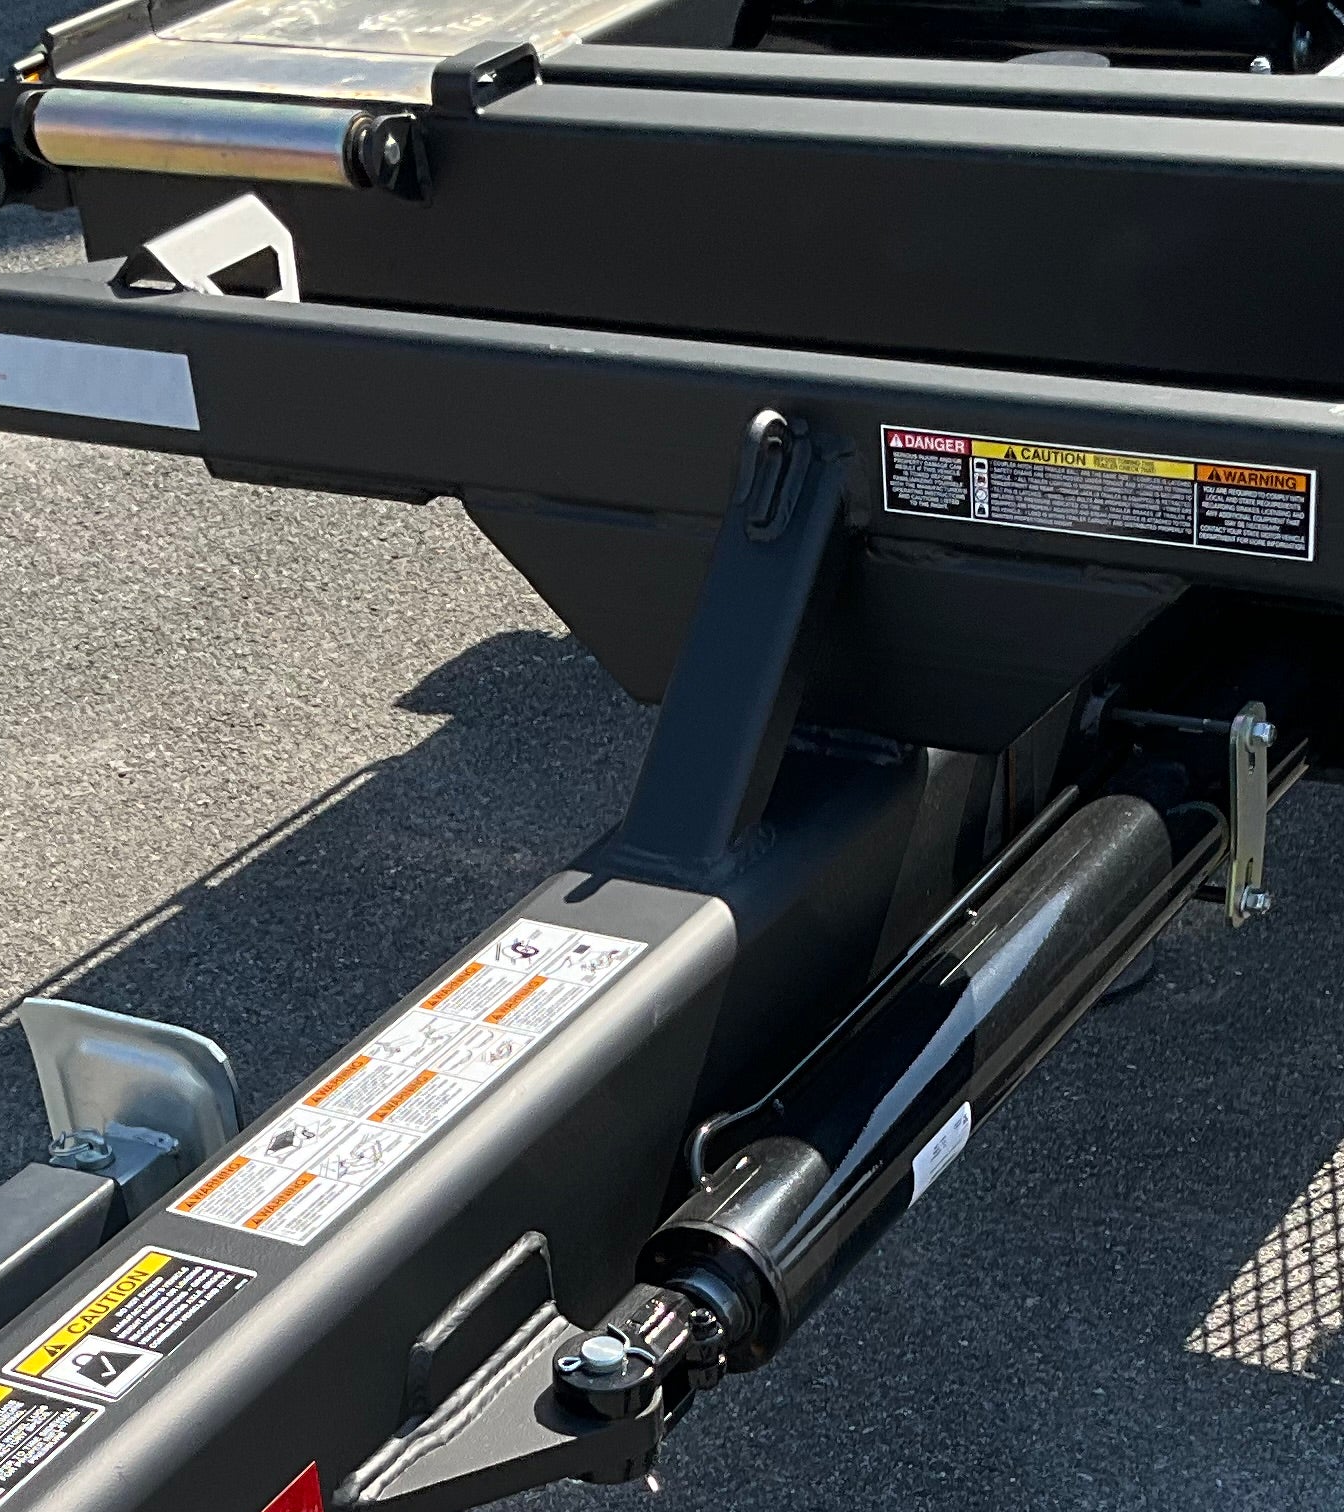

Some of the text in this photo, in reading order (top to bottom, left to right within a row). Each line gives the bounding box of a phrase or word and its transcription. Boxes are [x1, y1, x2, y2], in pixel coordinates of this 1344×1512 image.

[903, 433, 965, 453] DANGER
[1020, 447, 1086, 466] CAUTION
[1223, 469, 1297, 490] WARNING
[430, 966, 479, 1000] WARNING
[190, 1161, 243, 1200] WARNING
[257, 1178, 309, 1216] WARNING
[66, 1270, 149, 1334] CAUTION
